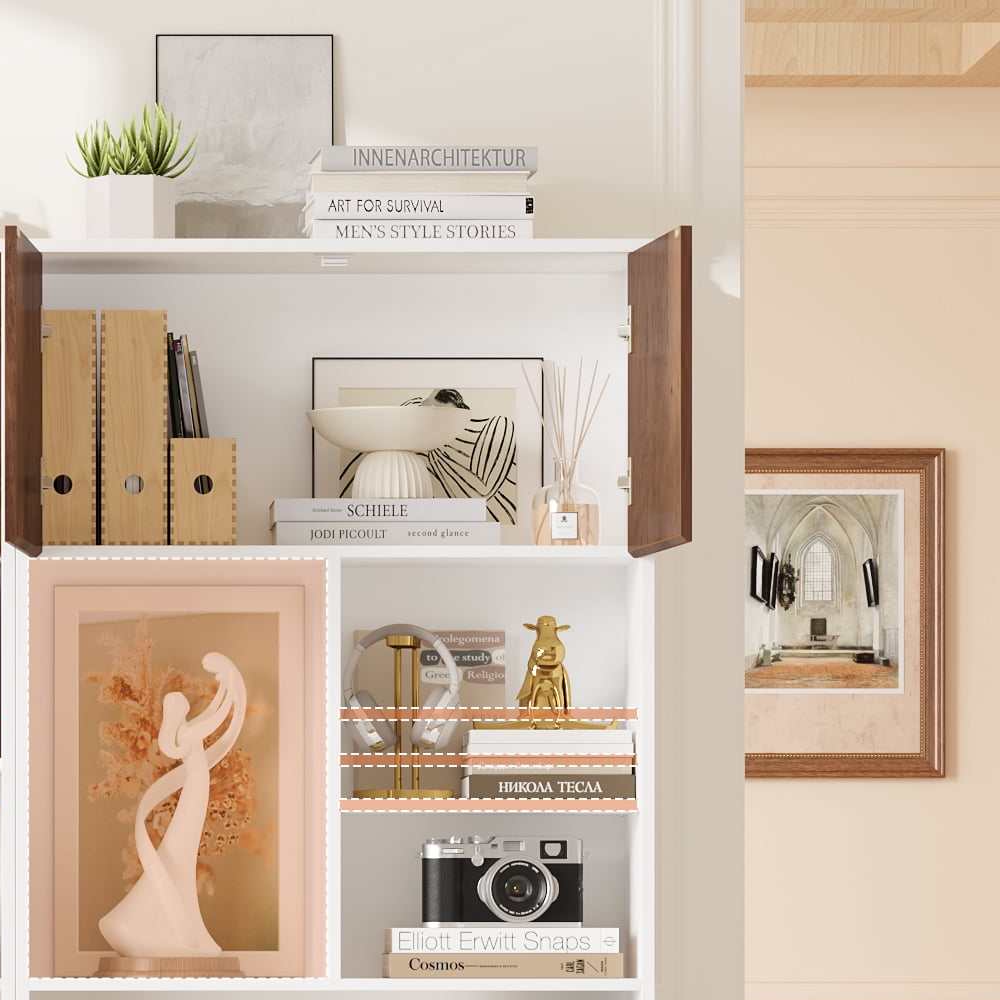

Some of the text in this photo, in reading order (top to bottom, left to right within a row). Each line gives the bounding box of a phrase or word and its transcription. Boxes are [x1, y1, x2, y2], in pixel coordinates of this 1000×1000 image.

[352, 148, 526, 167] INNENARCHITEKTUR
[327, 199, 445, 213] ART FOR SURVIVAL
[335, 224, 516, 239] MEN'S STYLE STORIES
[347, 503, 409, 518] SCHIELE
[310, 528, 469, 541] JODI PICOULT second glance
[434, 634, 500, 646] rolegomena
[426, 654, 438, 662] to
[462, 653, 490, 664] study
[425, 670, 451, 679] Gree
[498, 781, 603, 793] НИКОЛА ТЕСЛА
[398, 931, 591, 953] Elliott Erwitt Snaps
[408, 957, 465, 971] Cosmos
